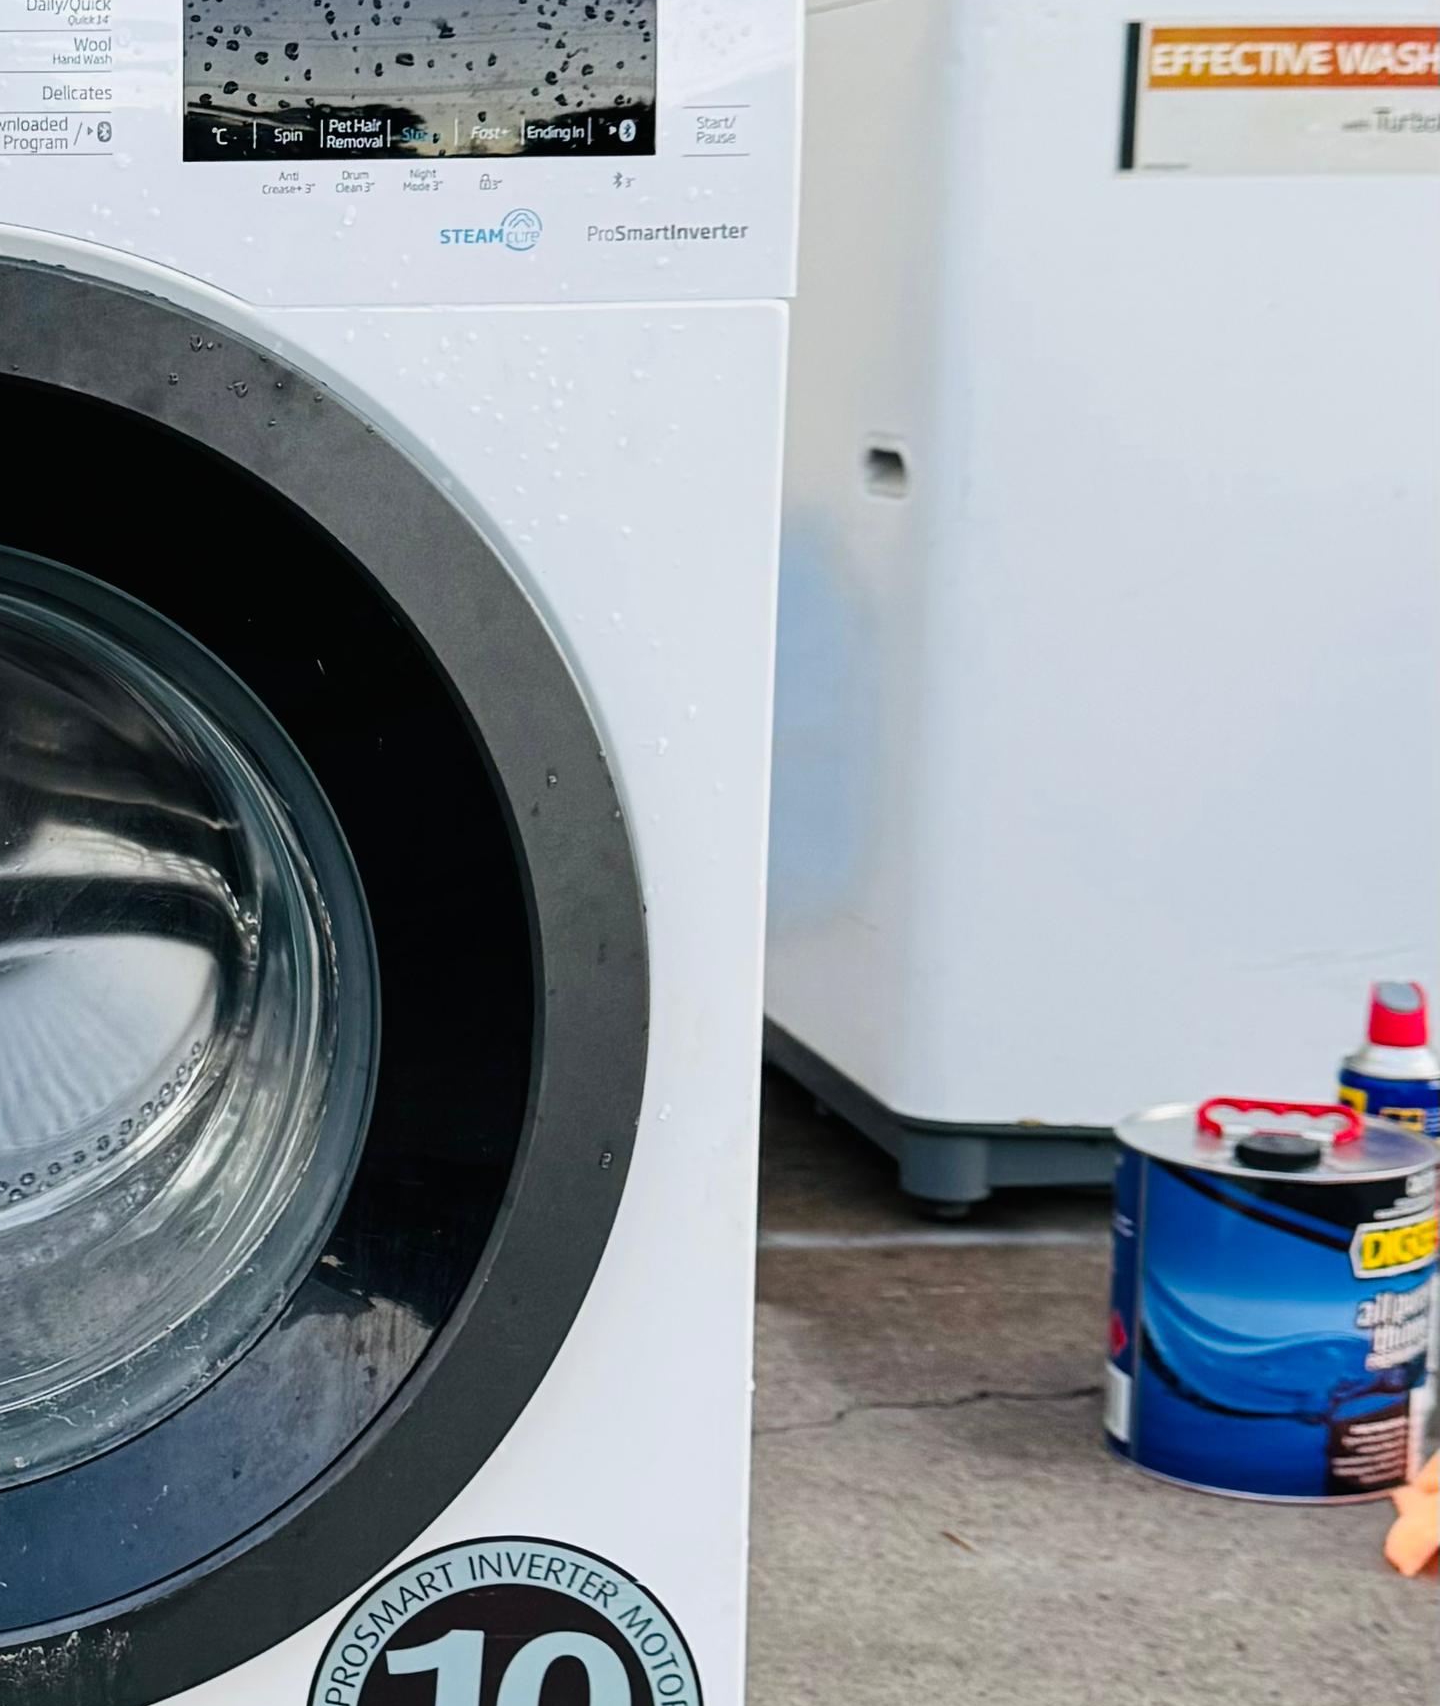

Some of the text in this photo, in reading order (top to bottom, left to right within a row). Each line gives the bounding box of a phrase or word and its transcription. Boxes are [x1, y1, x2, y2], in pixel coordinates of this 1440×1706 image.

[67, 15, 94, 26] Quick
[74, 37, 112, 51] Wool
[53, 54, 112, 64] Hand Wash
[1152, 42, 1332, 76] EFFECTIVE
[42, 85, 112, 100] Delicates
[329, 118, 381, 132] Pet Hair
[696, 115, 736, 129] Start/
[274, 128, 303, 144] Spin
[527, 126, 585, 142] Ending In
[696, 131, 736, 144] Pause
[3, 135, 68, 153] Program
[326, 135, 383, 149] Removal
[279, 172, 299, 181] Anti
[342, 171, 369, 180] Drum
[410, 169, 436, 181] Night
[336, 183, 363, 193] Clean
[403, 182, 430, 191] Mode
[587, 224, 748, 242] ProSmartInverter
[468, 1551, 619, 1610] INVERTER
